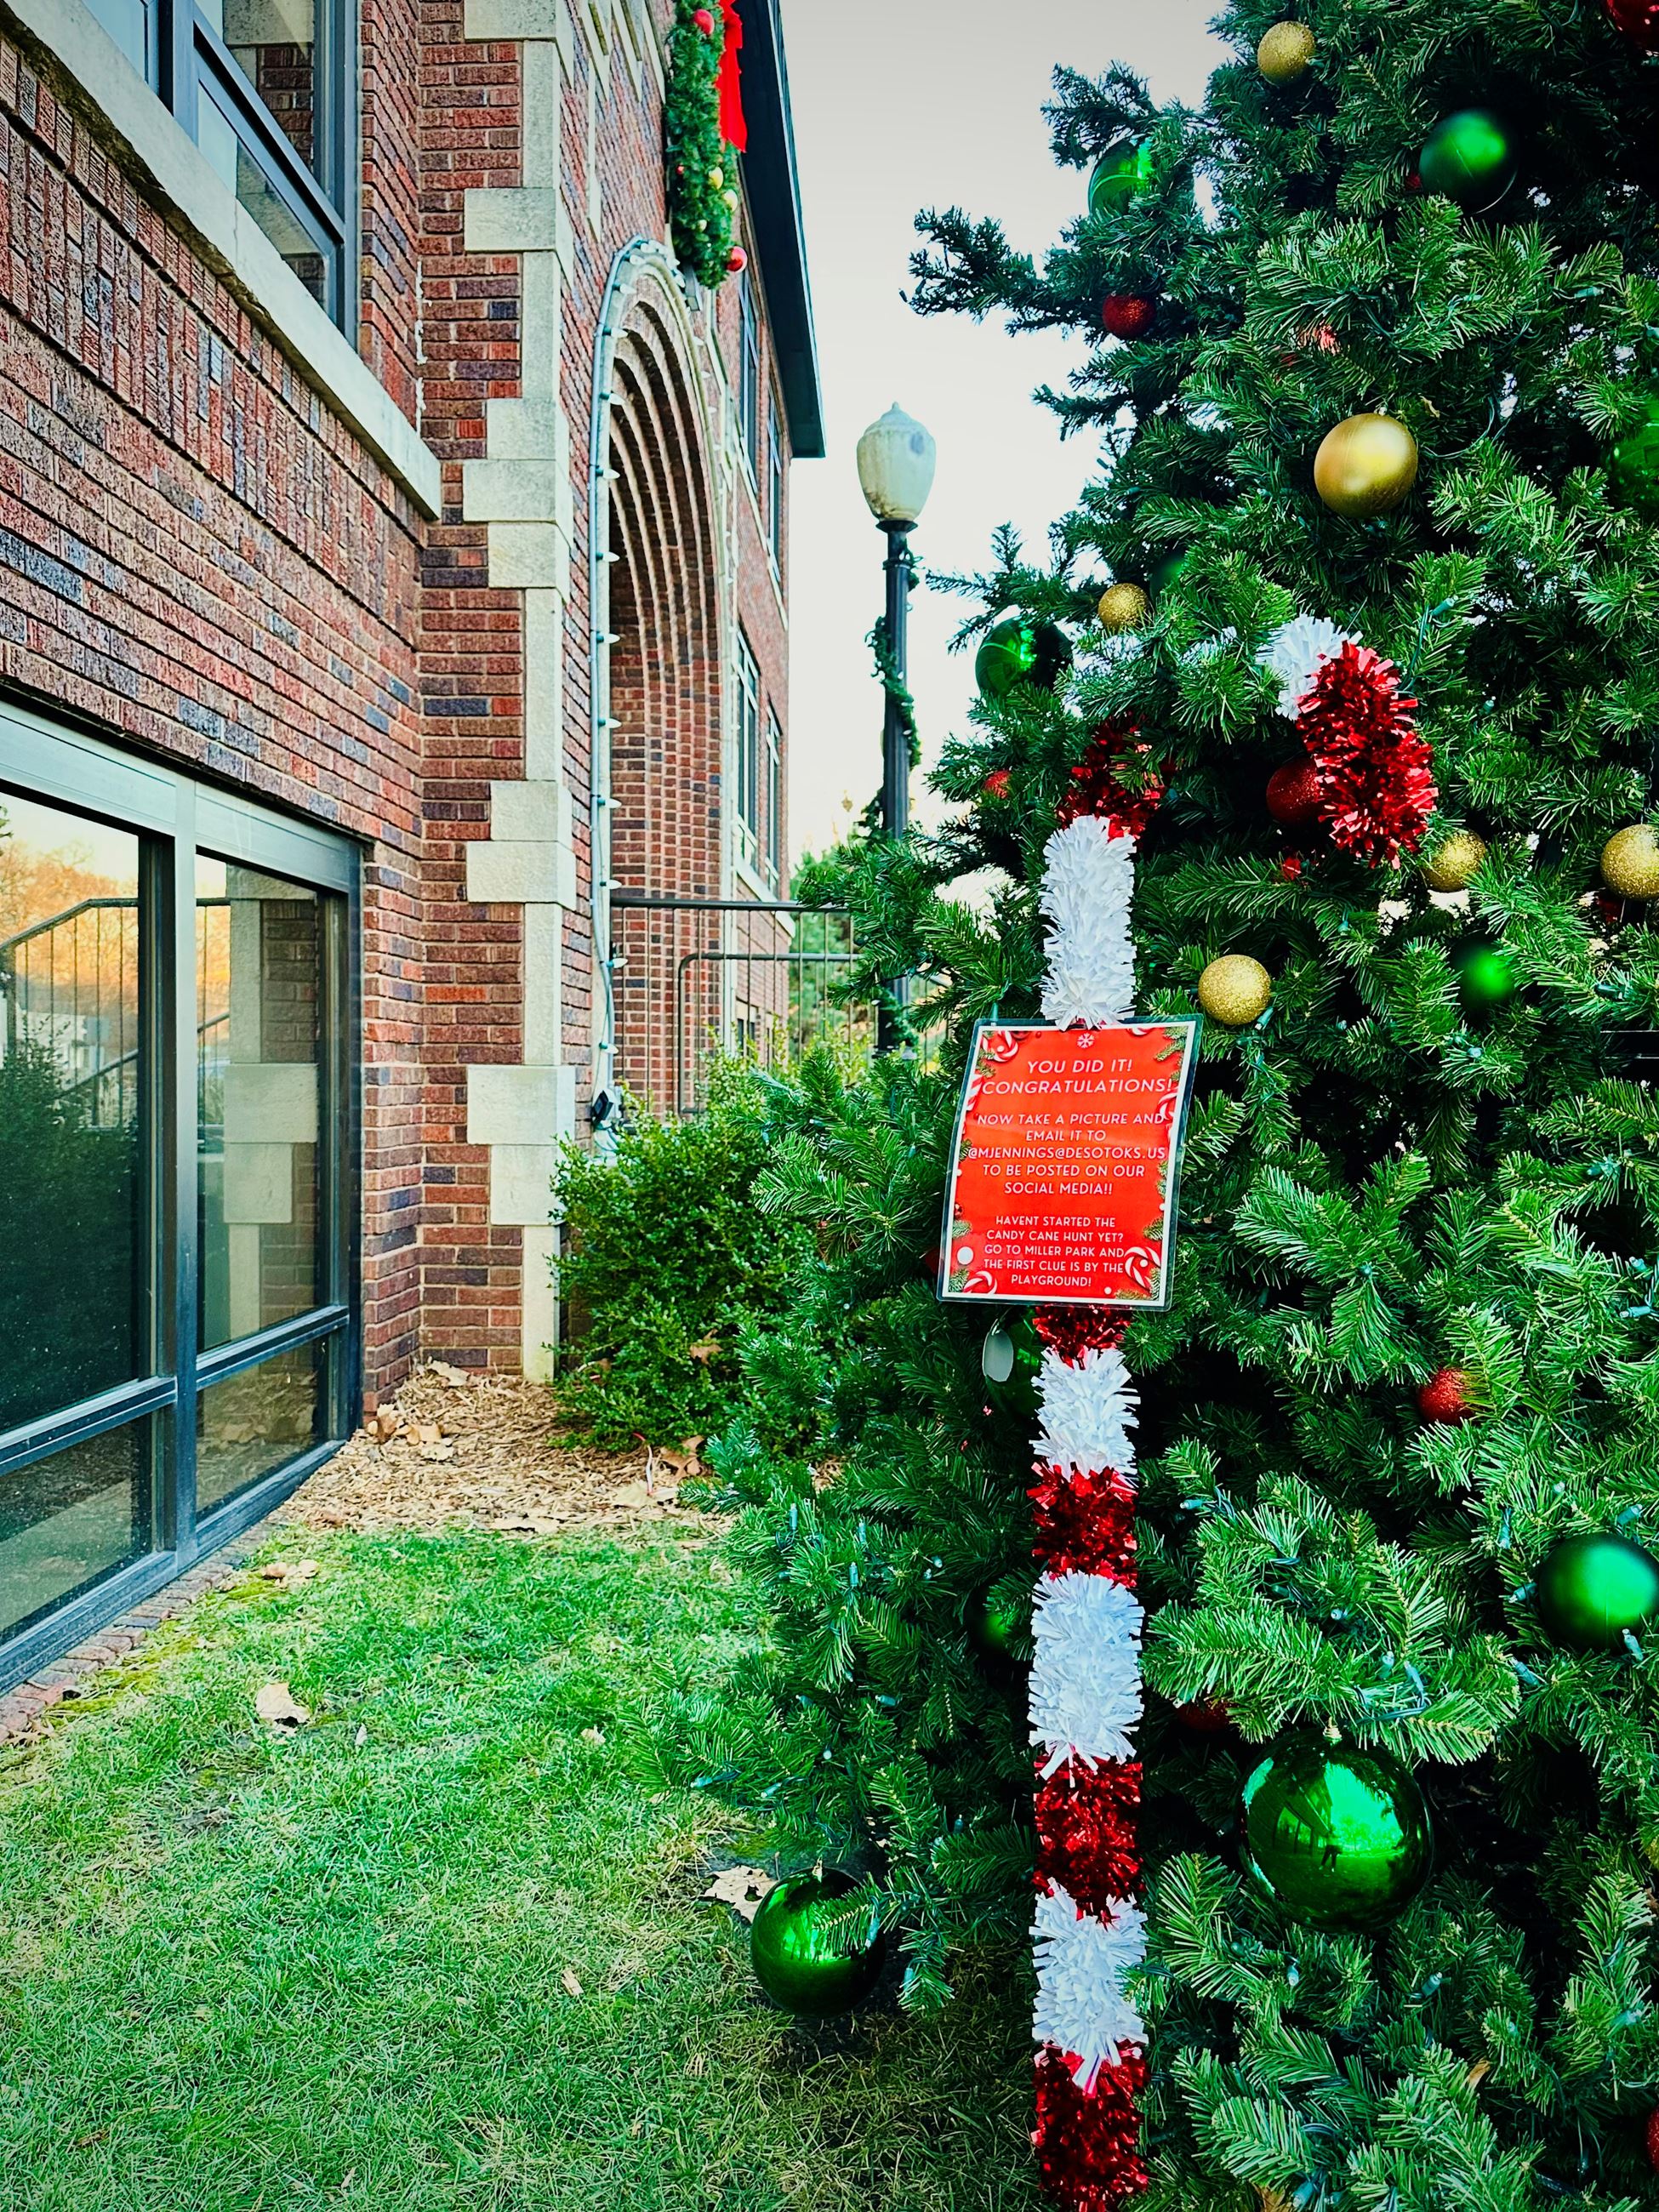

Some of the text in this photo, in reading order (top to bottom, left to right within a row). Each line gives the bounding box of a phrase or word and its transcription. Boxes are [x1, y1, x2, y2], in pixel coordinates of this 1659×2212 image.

[1028, 1059, 1132, 1074] YOU DID IT!
[982, 1078, 1172, 1095] CONGRATULATIONS!
[978, 1113, 1164, 1126] NOW TAKE A PICTURE AND
[1026, 1130, 1106, 1142] EMAIL IT TO
[968, 1147, 1166, 1160] @MJENNINGS@DESOTOKS.US
[983, 1165, 1144, 1177] TO BE POSTED ON OUR
[1004, 1183, 1113, 1195] SOCIAL MEDIA!!
[995, 1216, 1115, 1228] HAVENT STARTED THE
[986, 1230, 1124, 1243] CANDY CANE HUNT YET?
[984, 1245, 1125, 1258] GO TO MILLER PARK AND
[983, 1259, 1124, 1274] THE FIRST CLUE IS BY THE
[1012, 1274, 1092, 1286] PLAYGROUND!
